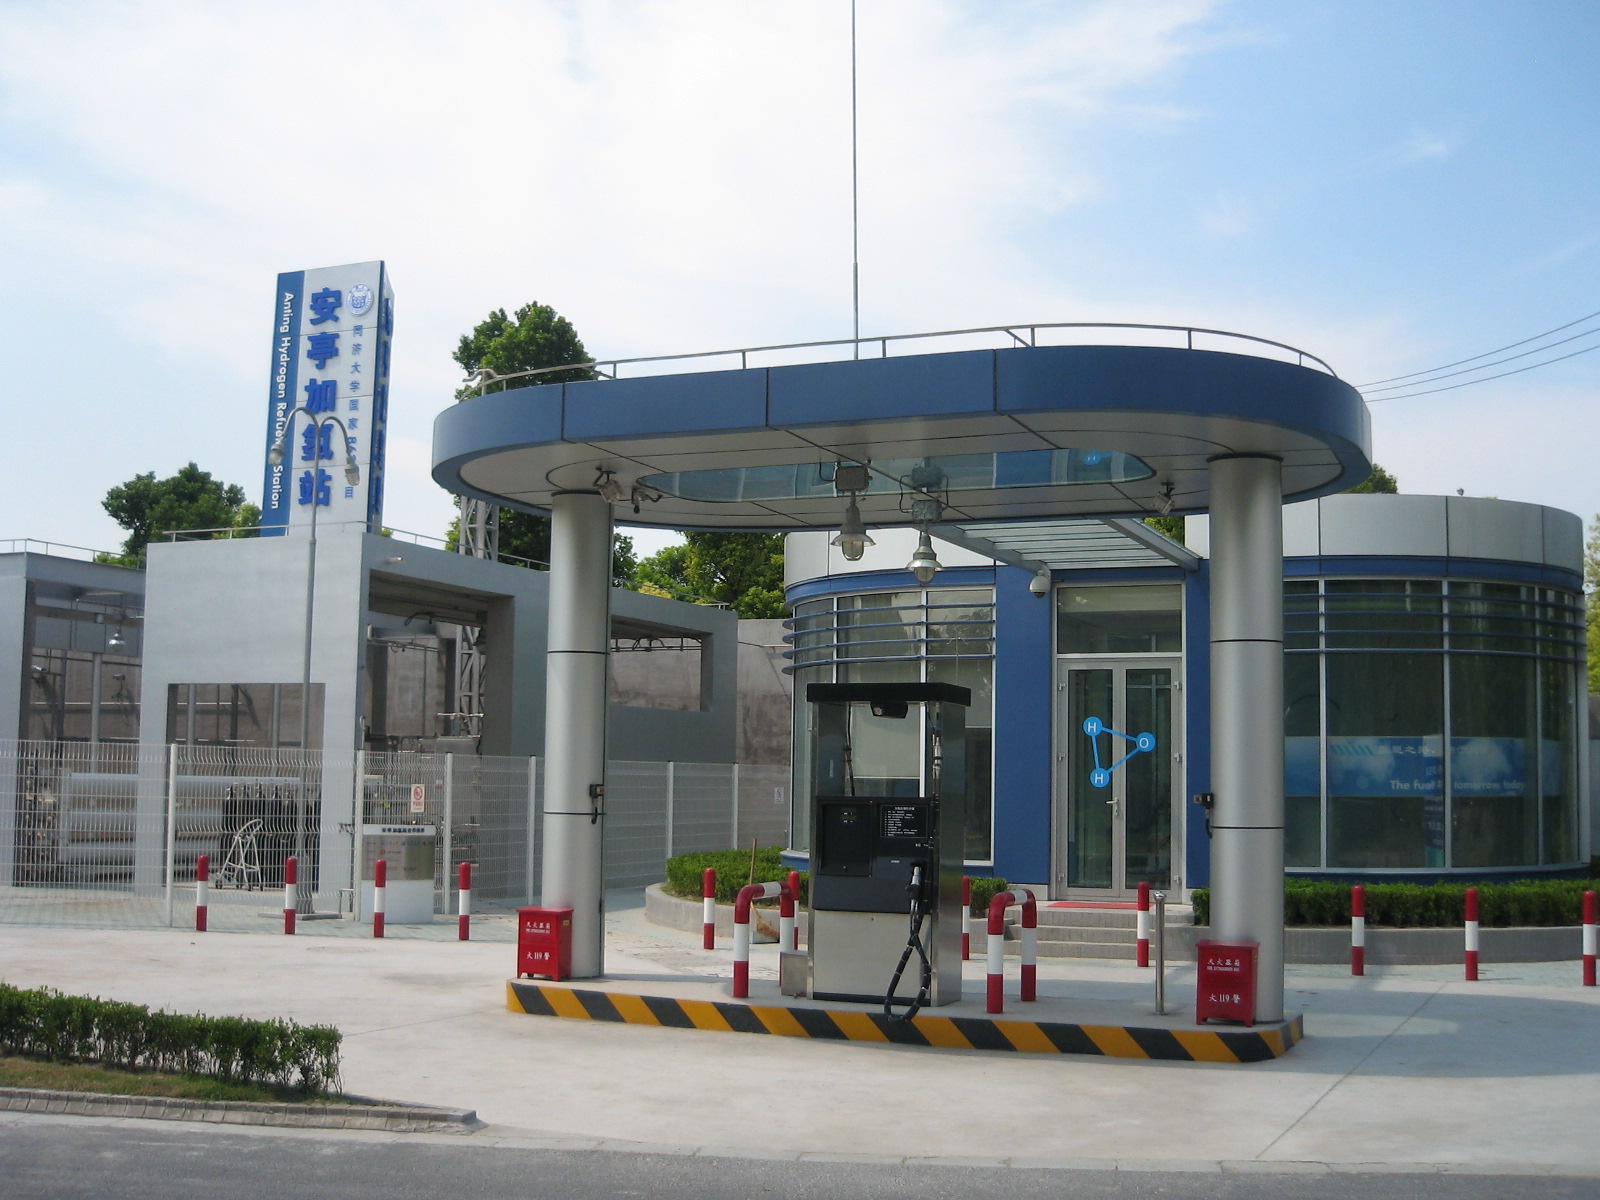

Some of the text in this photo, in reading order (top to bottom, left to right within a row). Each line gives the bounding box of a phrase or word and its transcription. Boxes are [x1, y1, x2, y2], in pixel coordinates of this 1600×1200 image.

[280, 292, 295, 333] Anting
[277, 337, 292, 399] Hydrogen
[298, 287, 342, 507] 安亭加氢站
[271, 465, 284, 509] Station
[1087, 722, 1097, 733] H
[1139, 737, 1149, 749] O
[1094, 773, 1104, 784] H
[1389, 779, 1410, 790] The
